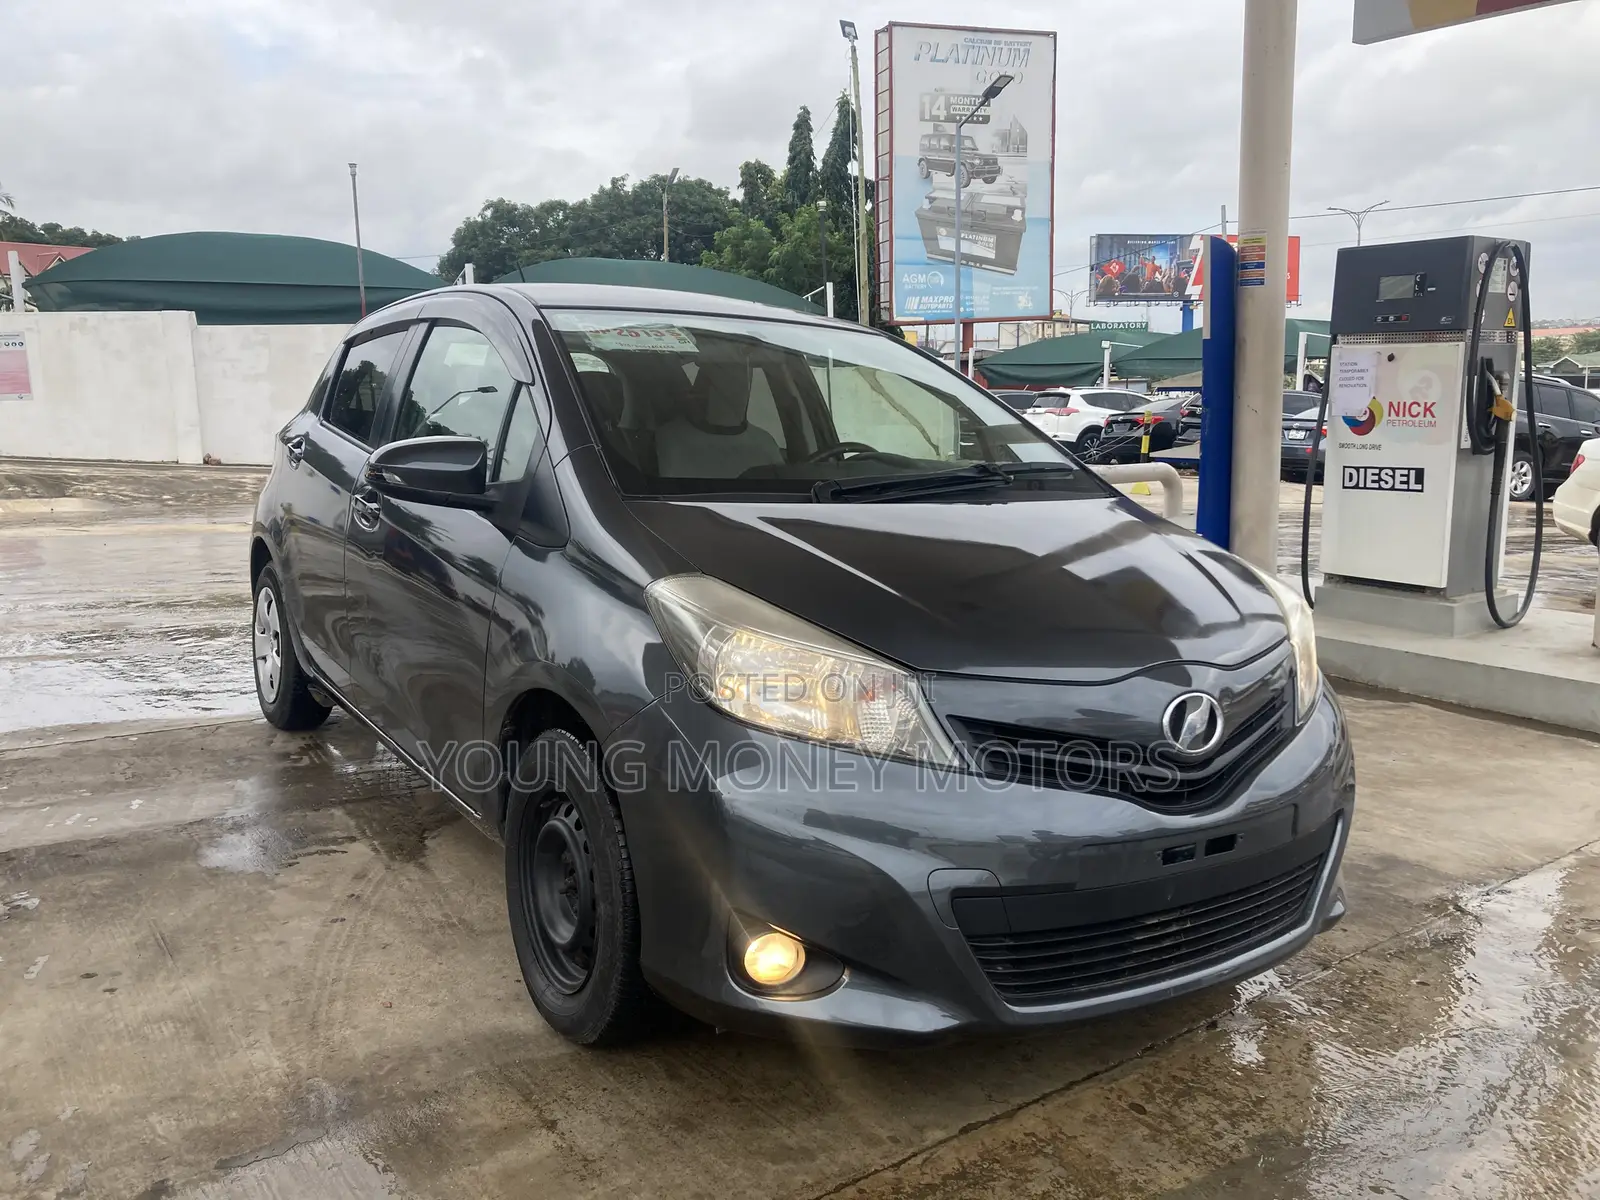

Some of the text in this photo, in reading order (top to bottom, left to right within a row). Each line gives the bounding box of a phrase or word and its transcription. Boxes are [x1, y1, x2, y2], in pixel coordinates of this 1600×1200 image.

[914, 41, 1031, 68] PLATINUM
[976, 70, 1024, 84] GOD
[950, 96, 988, 105] MONTH
[922, 95, 948, 120] 14
[951, 106, 988, 114] WARRATY
[902, 273, 926, 284] AGM
[921, 295, 954, 304] MAXPRO
[1091, 322, 1146, 330] LABORATORY
[1387, 401, 1437, 419] NICK
[1386, 419, 1437, 428] PETROLEUM
[1338, 442, 1356, 450] SMOOTH
[1368, 443, 1382, 451] DRIVE
[1343, 467, 1422, 490] DIESEL
